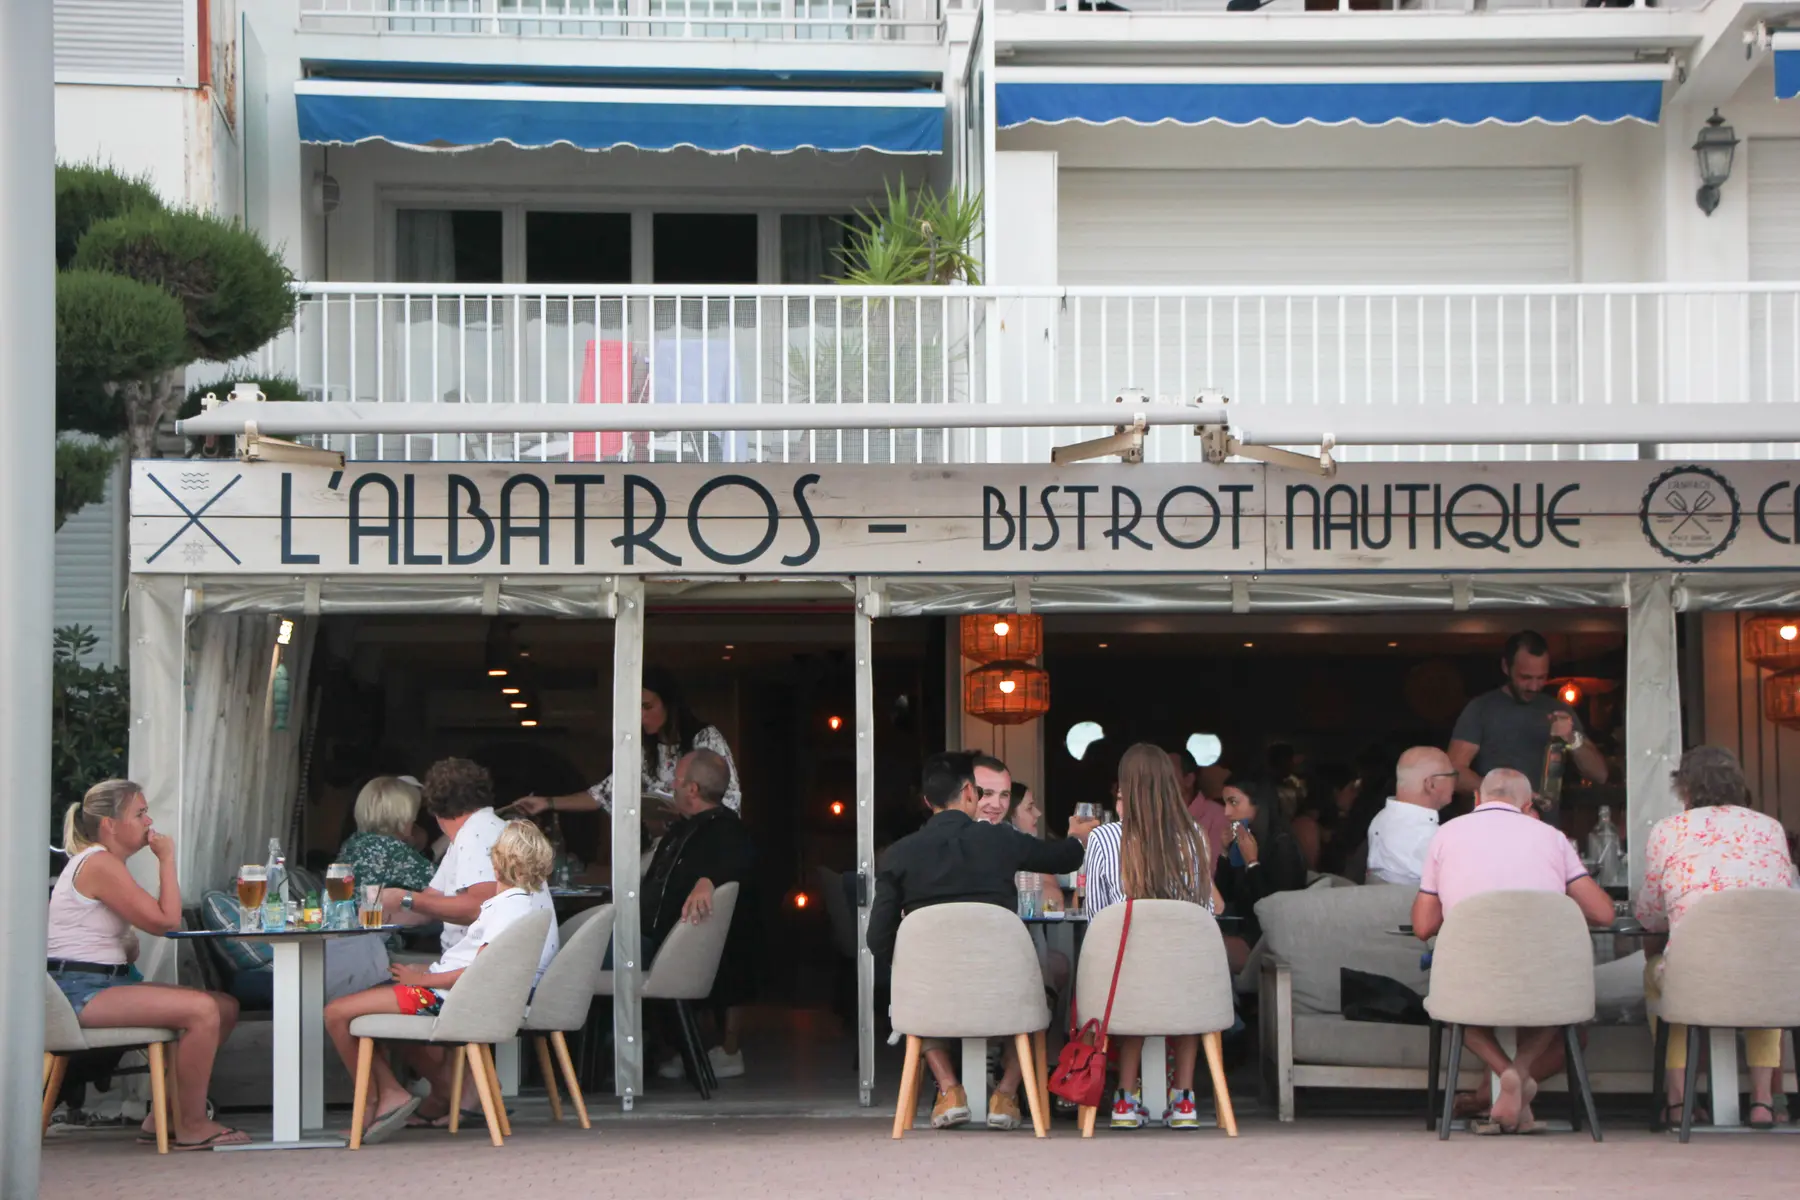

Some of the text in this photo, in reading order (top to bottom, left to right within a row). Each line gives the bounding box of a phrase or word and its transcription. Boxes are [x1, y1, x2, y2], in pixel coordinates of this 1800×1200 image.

[281, 470, 1800, 567] L'ALBATROS - BISTROT NAUTIQUE C
